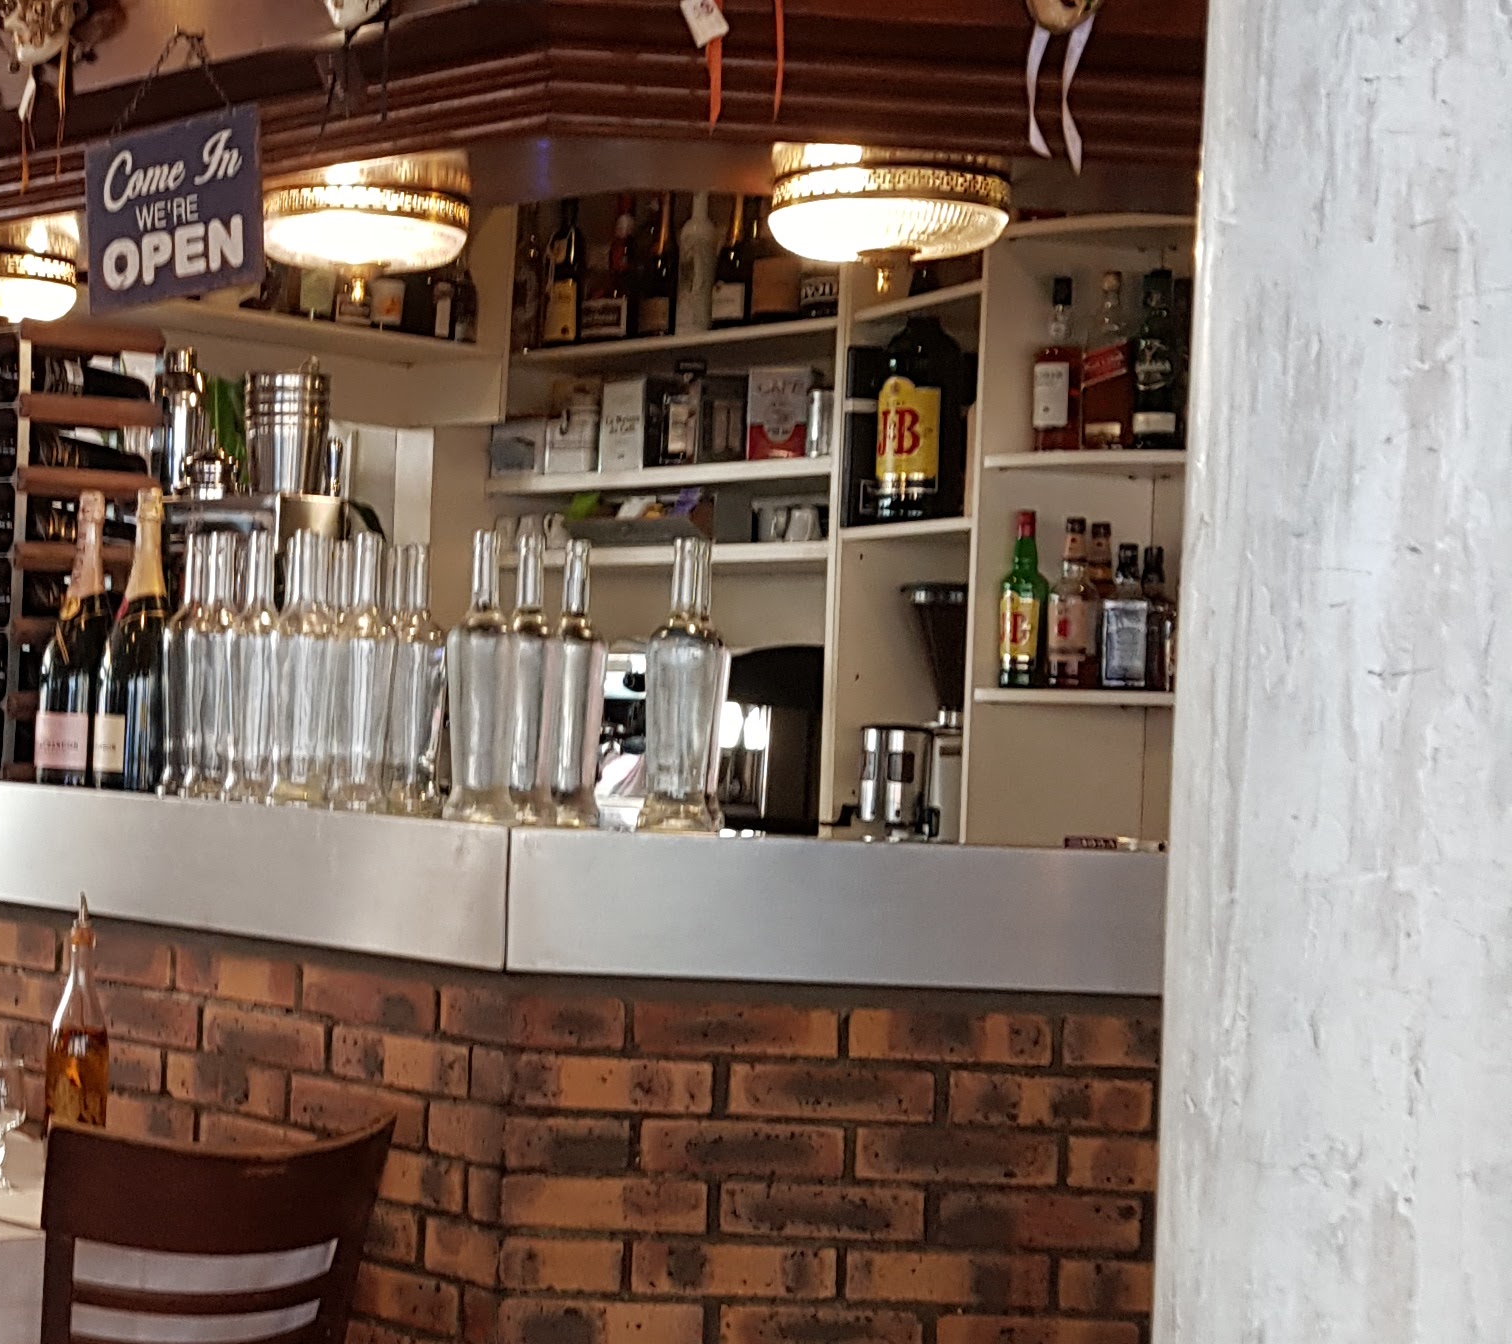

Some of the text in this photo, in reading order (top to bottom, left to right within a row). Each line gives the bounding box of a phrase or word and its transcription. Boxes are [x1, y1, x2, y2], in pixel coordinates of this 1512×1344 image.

[103, 128, 243, 213] Come In
[102, 213, 245, 291] OPEN
[135, 193, 199, 233] WE'RE
